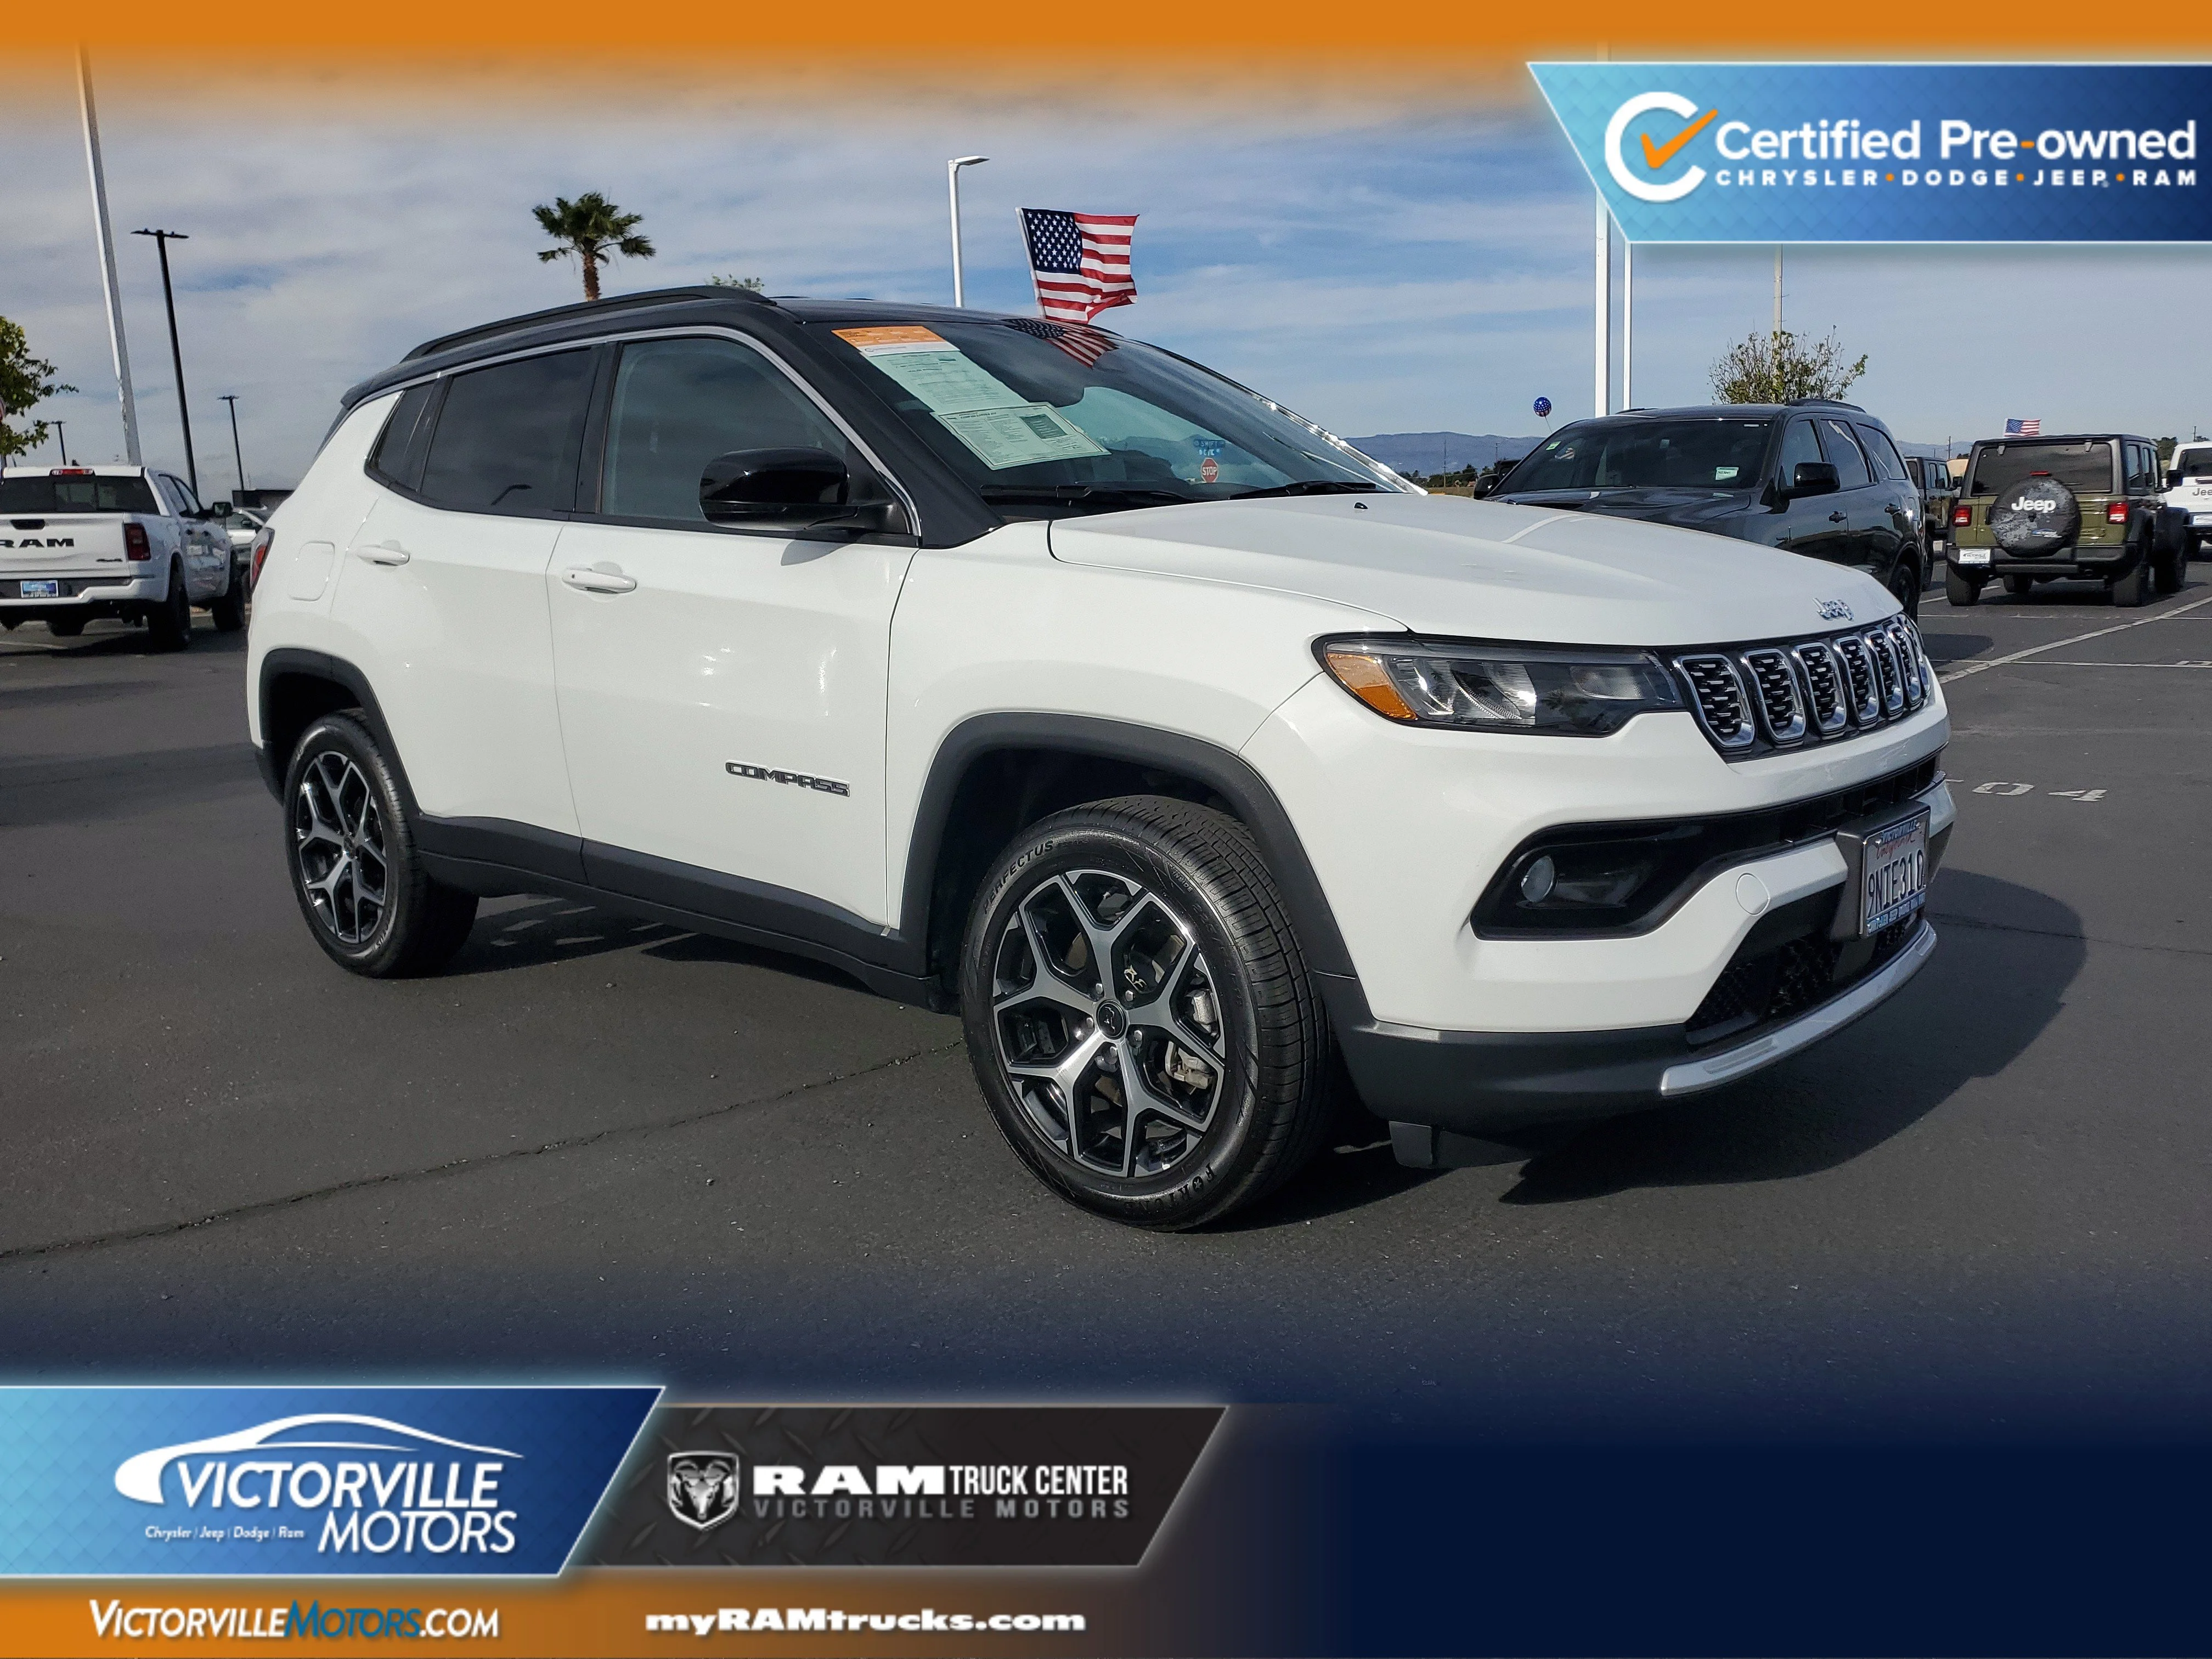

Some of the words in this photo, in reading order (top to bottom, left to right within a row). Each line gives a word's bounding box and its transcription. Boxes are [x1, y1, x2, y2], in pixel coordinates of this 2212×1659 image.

[1202, 466, 1217, 476] STOP
[2192, 488, 2212, 496] Jee
[2011, 496, 2056, 513] Jeep
[725, 761, 850, 797] COMPASS
